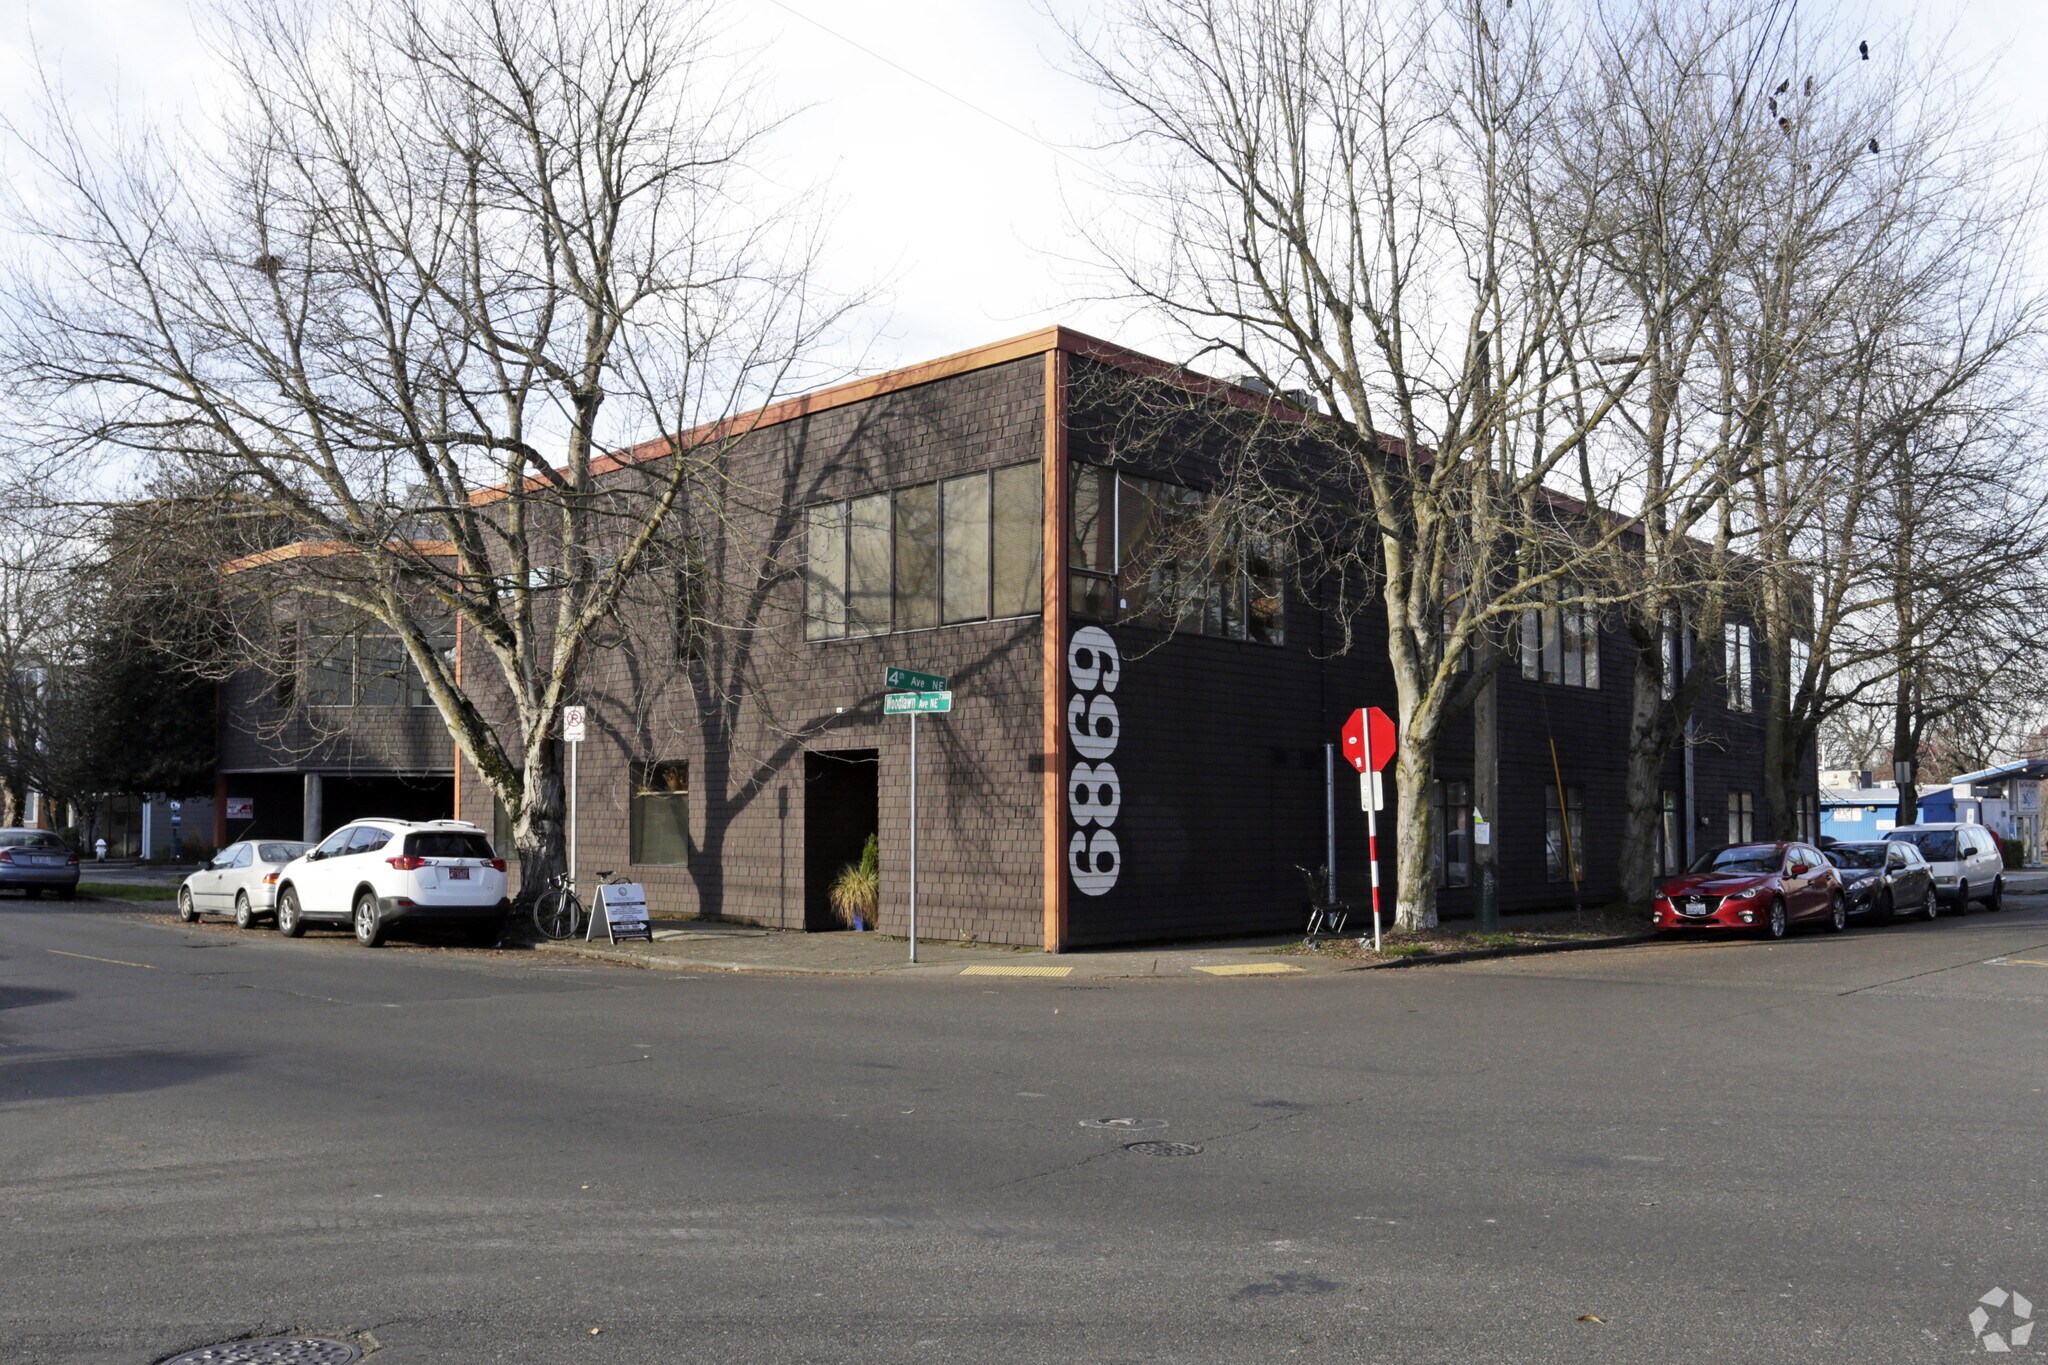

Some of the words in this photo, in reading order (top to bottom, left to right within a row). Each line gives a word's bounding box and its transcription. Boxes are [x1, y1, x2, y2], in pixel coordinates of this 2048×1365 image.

[888, 671, 905, 685] 4th
[911, 676, 925, 688] Ave
[932, 680, 944, 691] NE
[886, 696, 916, 710] Woodlawn
[918, 700, 929, 709] Ave
[930, 698, 938, 708] NE
